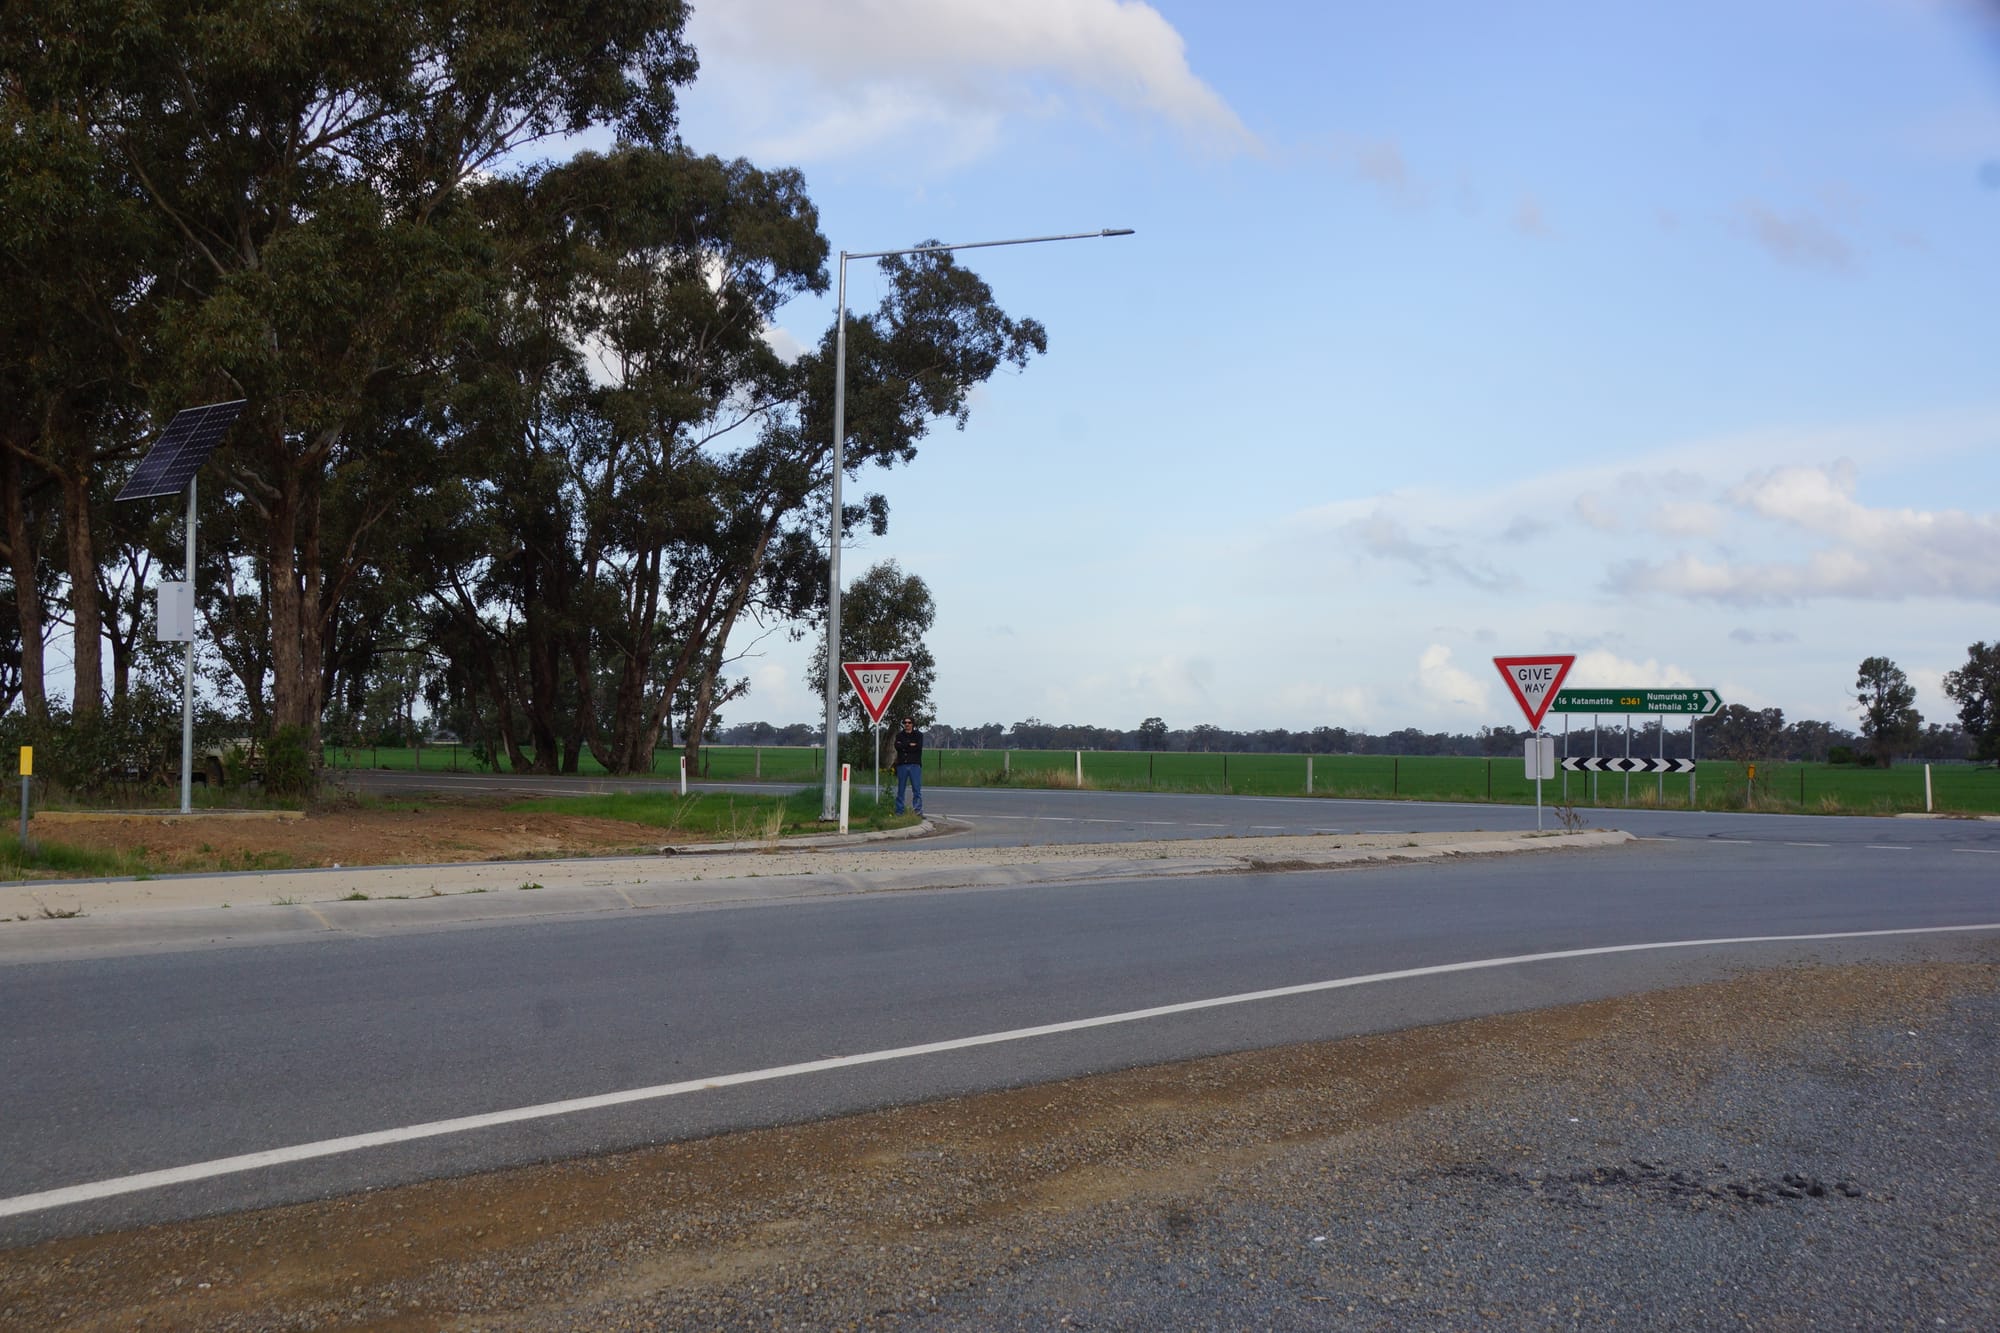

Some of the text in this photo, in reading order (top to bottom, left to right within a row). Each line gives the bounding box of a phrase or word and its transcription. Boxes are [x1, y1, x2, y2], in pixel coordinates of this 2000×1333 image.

[862, 674, 891, 684] GIVE
[1518, 668, 1552, 681] GIVE
[867, 686, 885, 694] WAY
[1524, 683, 1546, 693] WAY
[1558, 697, 1640, 705] 16 Katamatite C361
[1648, 703, 1698, 711] Nathalia 33
